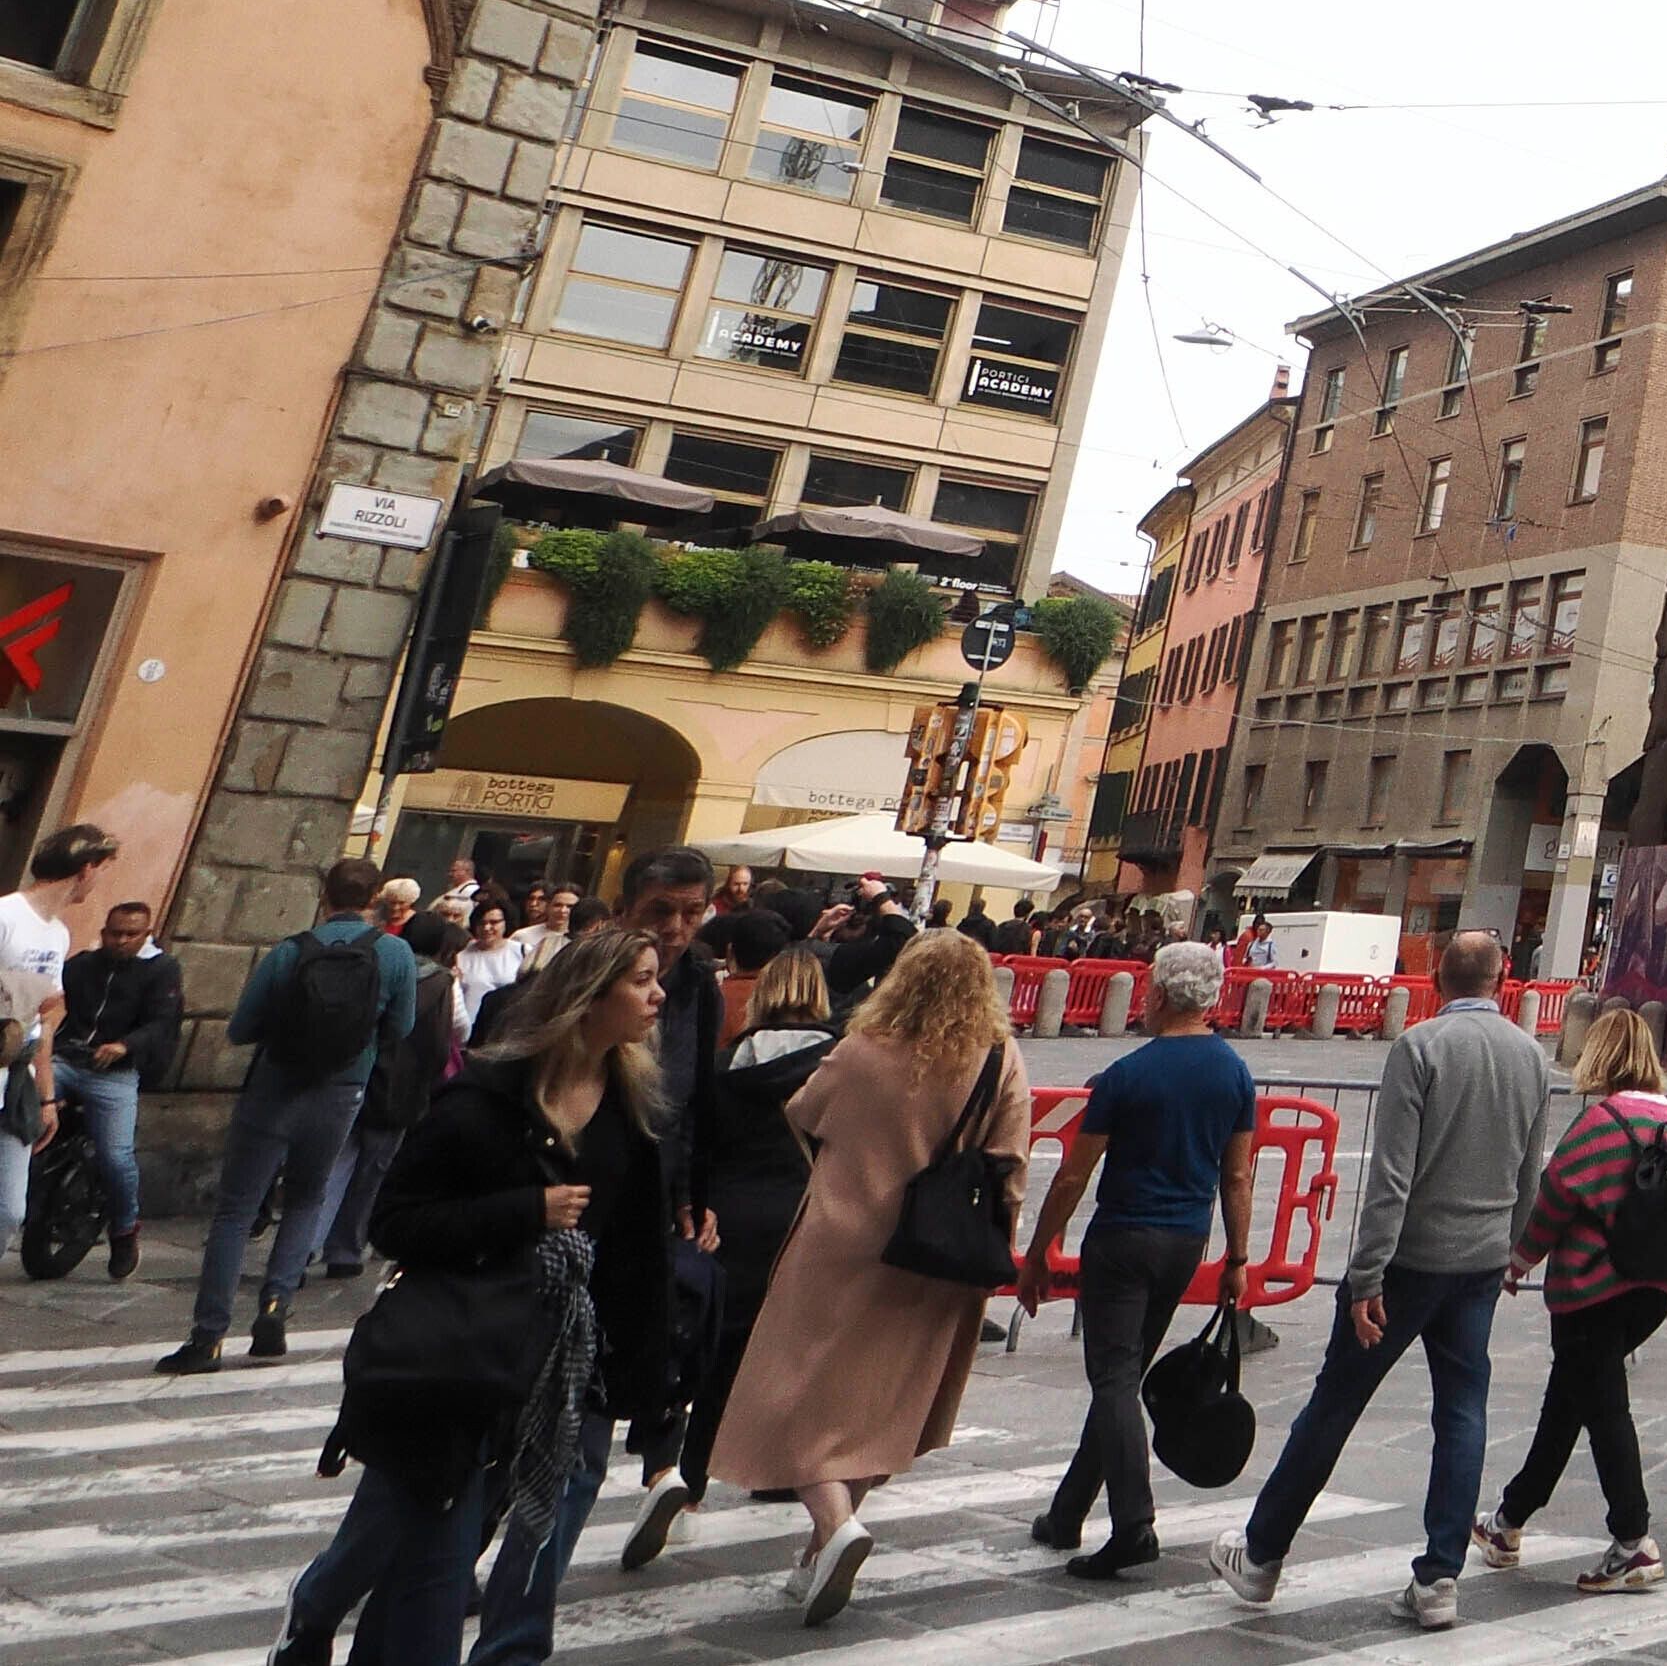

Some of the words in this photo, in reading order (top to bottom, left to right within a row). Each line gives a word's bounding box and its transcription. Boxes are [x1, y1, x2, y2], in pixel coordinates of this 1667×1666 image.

[719, 329, 802, 352] ACADEMY
[981, 367, 1030, 384] PORTICI
[979, 377, 1053, 398] ACADEMY
[375, 496, 396, 511] VIA
[354, 509, 408, 528] RIZZOLI
[952, 577, 978, 591] floor
[487, 777, 555, 794] bottega
[808, 790, 876, 811] bottega
